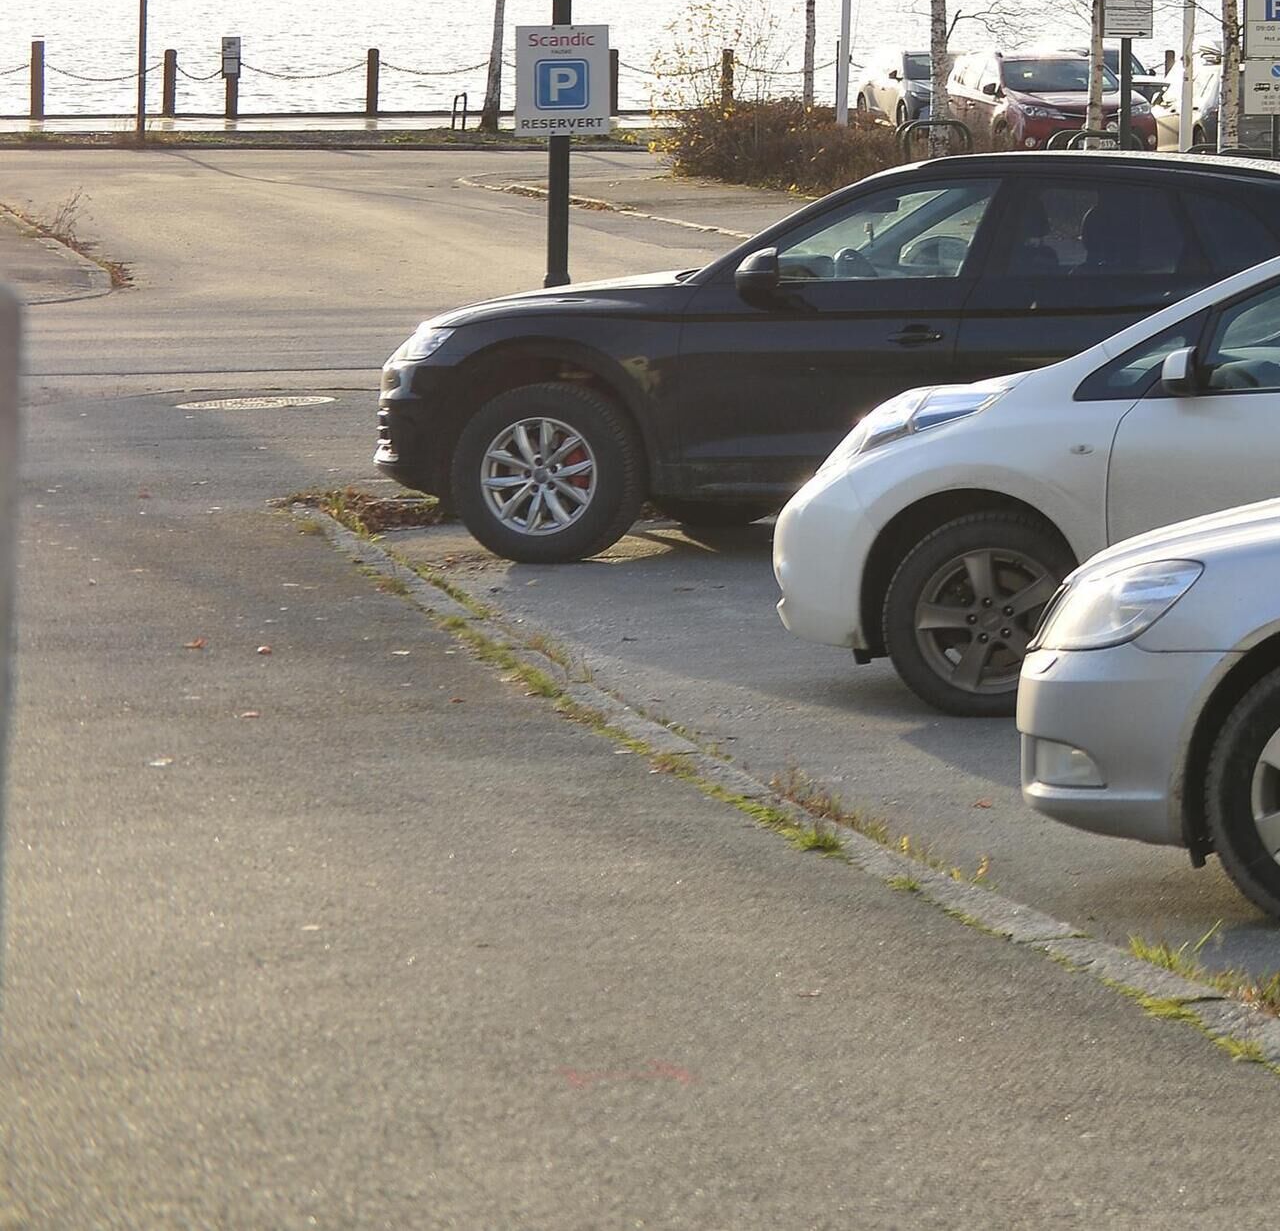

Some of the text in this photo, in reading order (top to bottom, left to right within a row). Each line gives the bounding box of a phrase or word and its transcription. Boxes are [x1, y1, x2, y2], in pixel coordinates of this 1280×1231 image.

[528, 32, 596, 48] Scandic
[549, 68, 577, 102] P
[521, 117, 604, 130] RESERVERT
